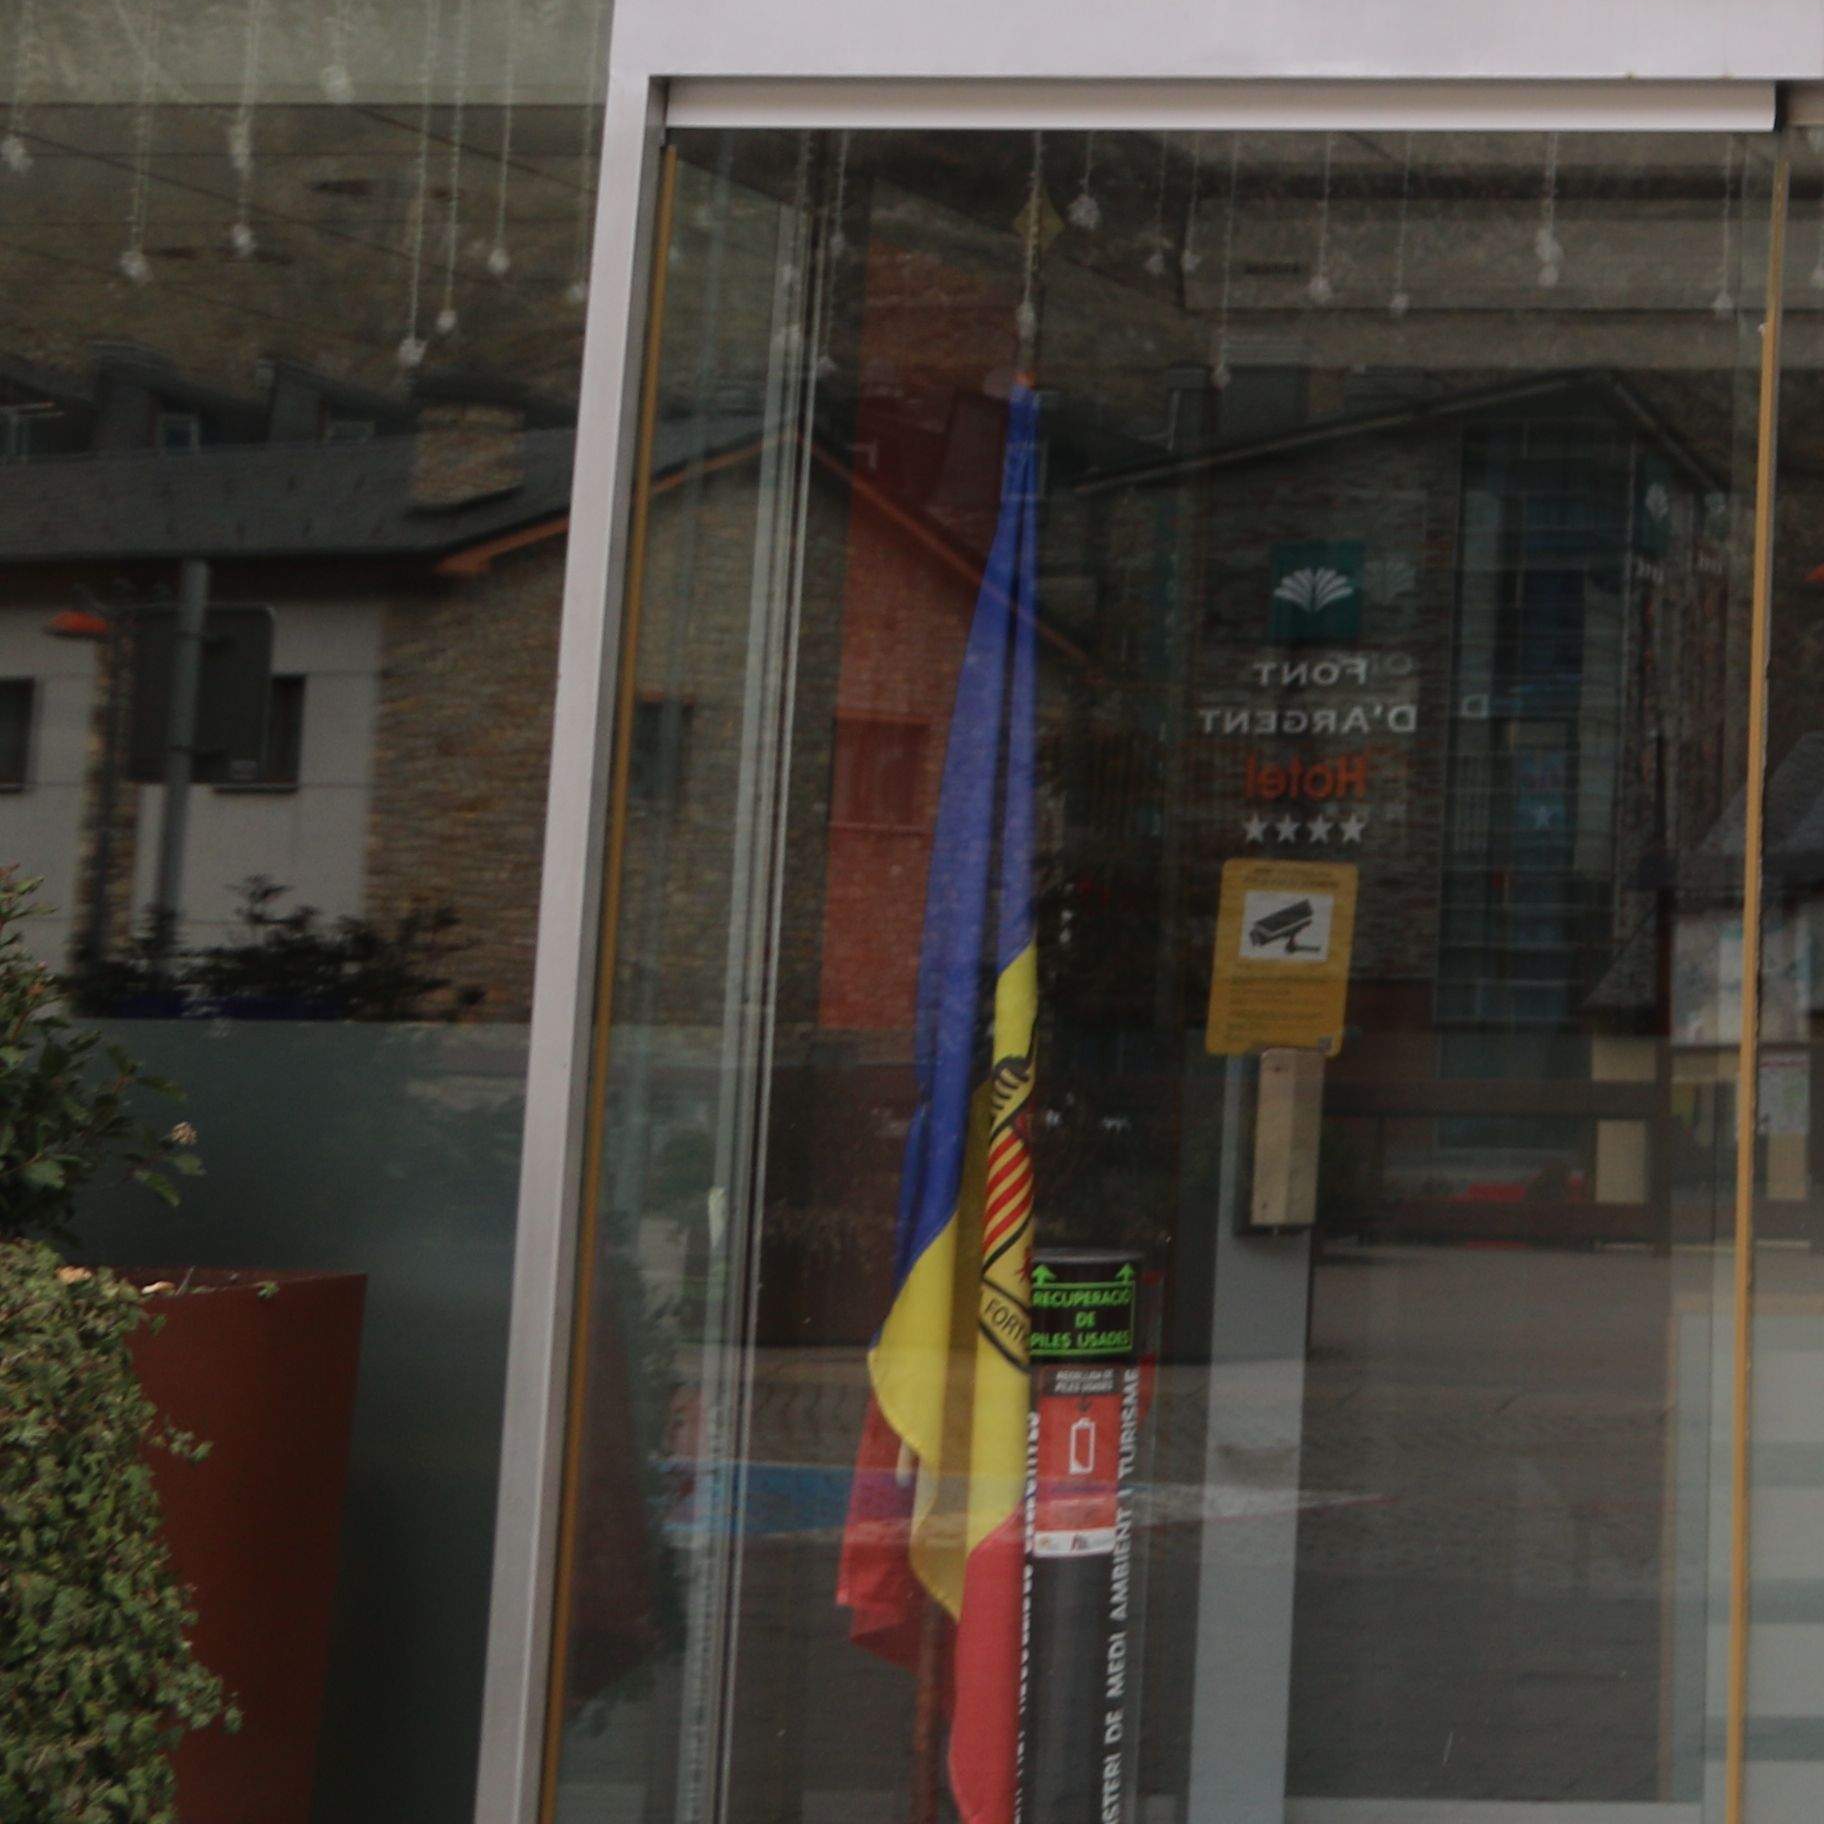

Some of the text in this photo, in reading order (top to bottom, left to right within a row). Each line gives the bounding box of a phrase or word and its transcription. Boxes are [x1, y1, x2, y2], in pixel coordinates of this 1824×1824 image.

[1075, 1310, 1096, 1329] DE
[1117, 1367, 1140, 1479] TURISME
[1110, 1507, 1133, 1622] AMBIENT
[1107, 1631, 1128, 1698] MEDI
[1104, 1706, 1125, 1745] DE
